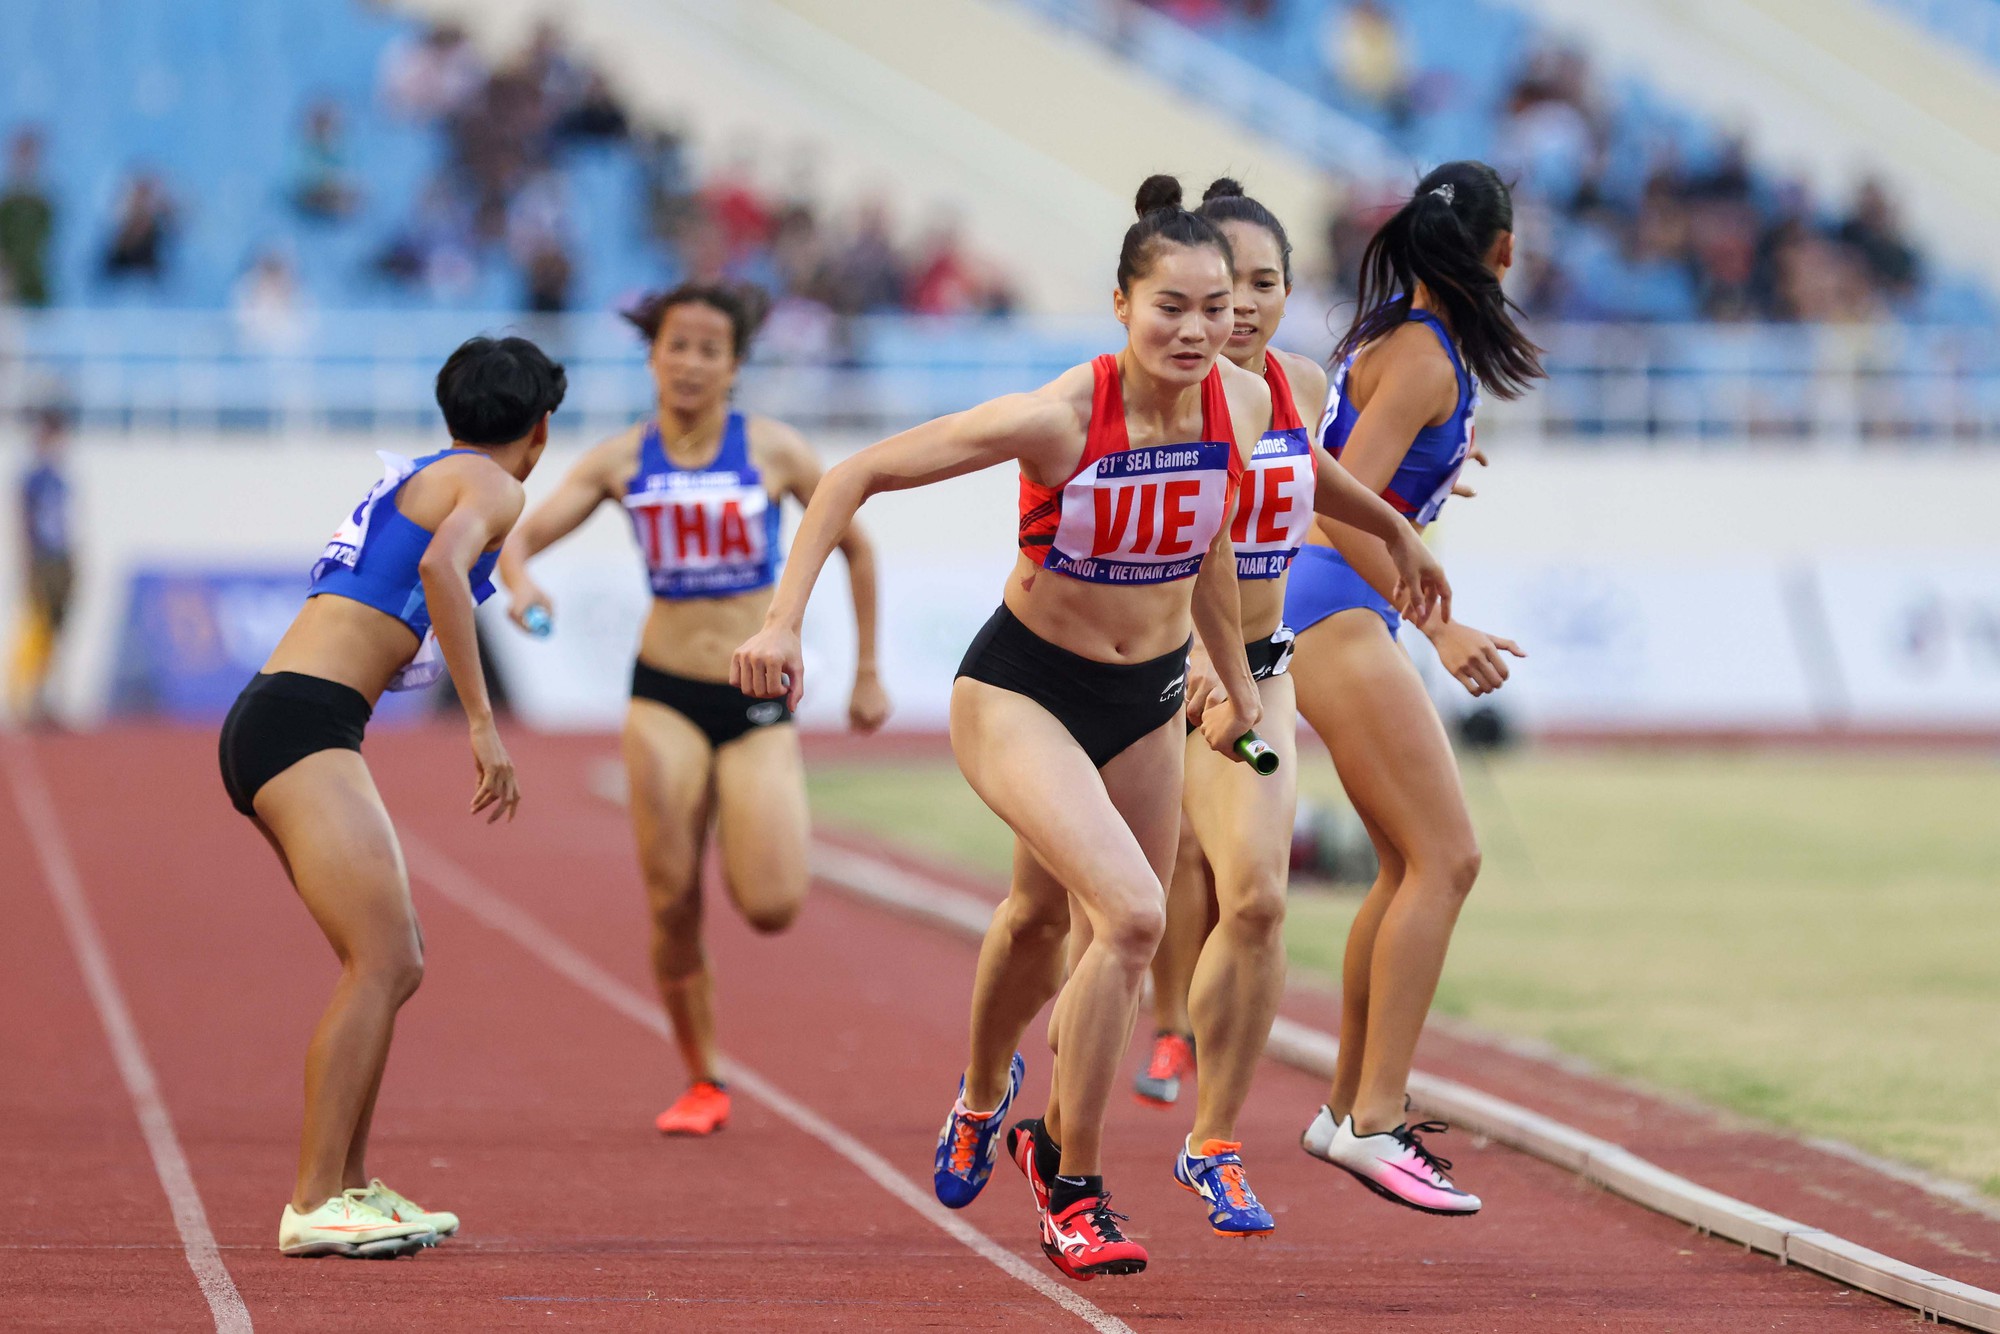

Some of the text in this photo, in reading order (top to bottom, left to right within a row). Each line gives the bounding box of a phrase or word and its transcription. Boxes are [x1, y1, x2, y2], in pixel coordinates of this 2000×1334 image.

[1126, 452, 1151, 472] SEA
[1155, 450, 1199, 469] Games
[1092, 480, 1200, 556] VIE
[1230, 466, 1294, 544] IE
[639, 502, 752, 567] THA
[1109, 565, 1166, 580] VIETNAM
[1269, 555, 1287, 573] 20
